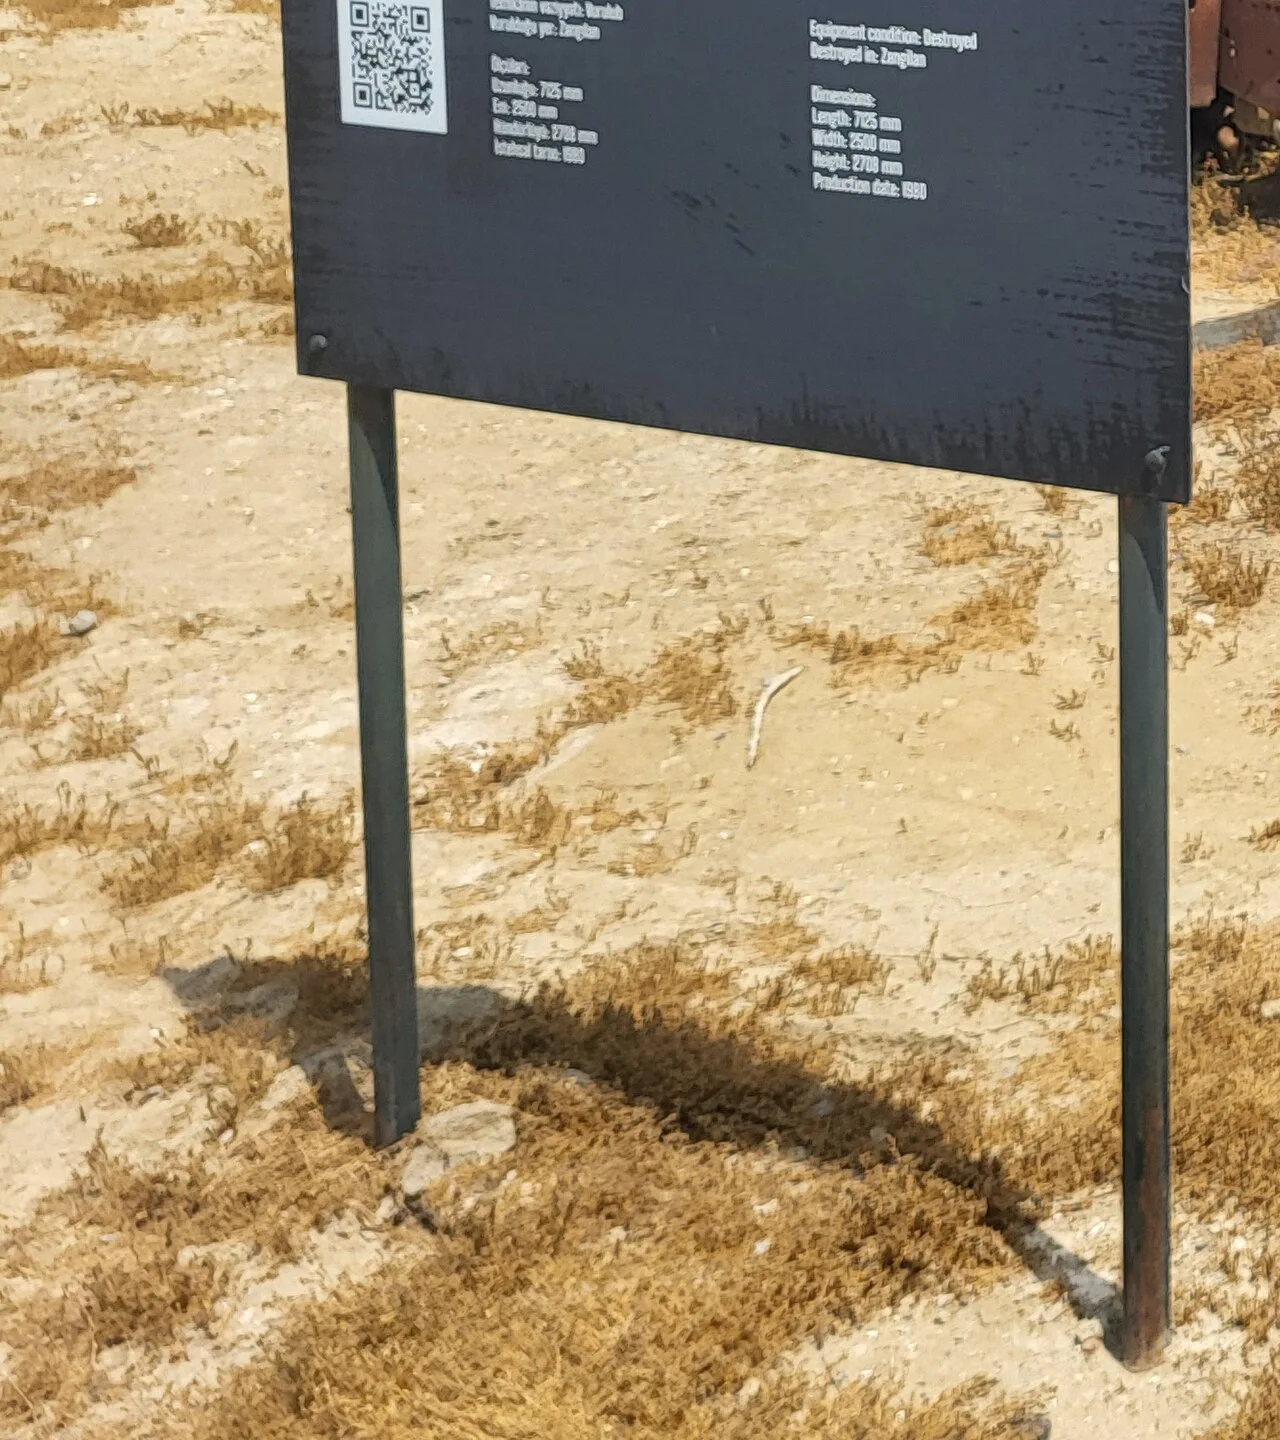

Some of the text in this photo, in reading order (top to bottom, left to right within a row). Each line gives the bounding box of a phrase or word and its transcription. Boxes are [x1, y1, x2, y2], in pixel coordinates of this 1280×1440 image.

[808, 18, 978, 53] Equipment condition: Destroyed
[809, 41, 863, 66] Destroyed
[811, 106, 902, 132] Length: 7125 mm
[811, 128, 901, 154] Width: 2500 mm
[811, 149, 851, 172] Height:
[880, 160, 903, 177] mm
[812, 171, 871, 195] Production
[871, 178, 900, 199] date:
